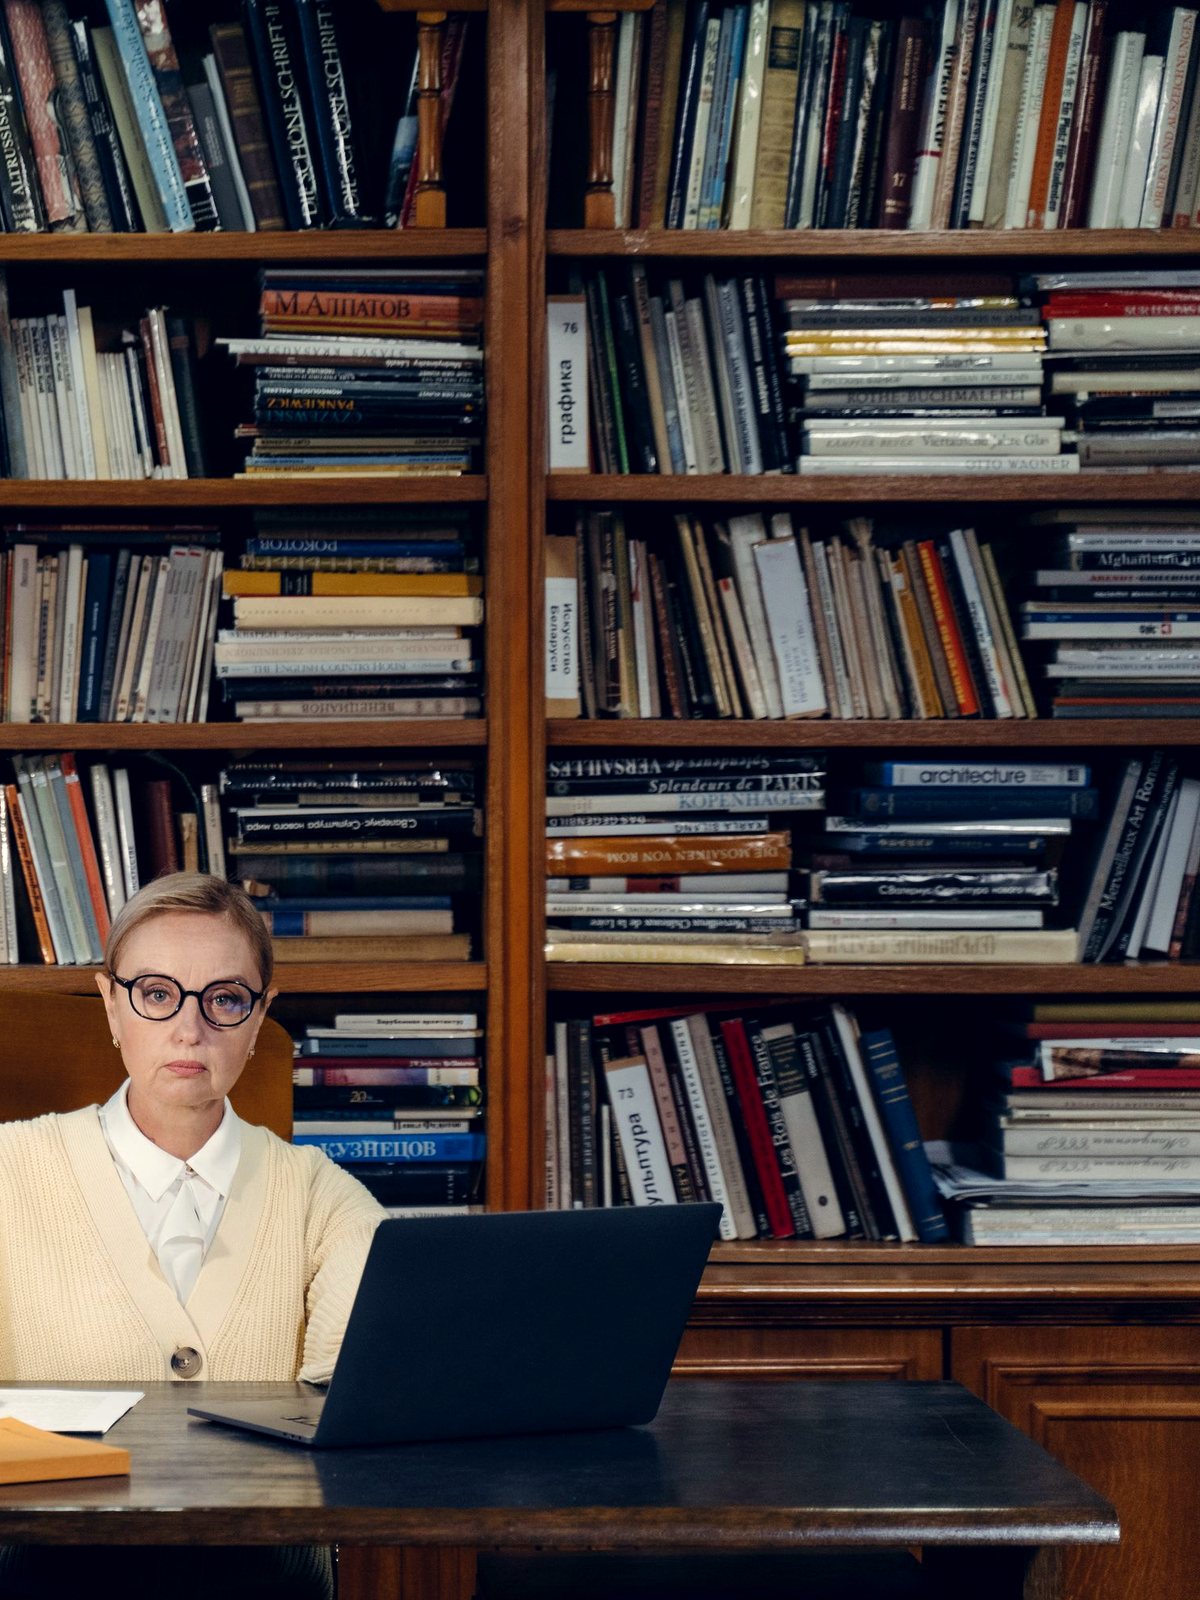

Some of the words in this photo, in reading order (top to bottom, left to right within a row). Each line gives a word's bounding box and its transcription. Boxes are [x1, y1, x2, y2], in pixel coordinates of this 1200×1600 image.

[1163, 14, 1196, 127] AUSZEICHNUNGEN
[1060, 100, 1073, 114] Ein
[1056, 116, 1071, 141] Platz
[1055, 143, 1067, 158] für
[1160, 130, 1175, 160] UND
[892, 172, 905, 187] 17
[1046, 160, 1064, 212] Studenten
[1152, 163, 1170, 208] ORDEN
[275, 291, 411, 318] М.АЛПАТОВ
[562, 322, 578, 334] 76
[243, 344, 340, 357] KRASAUSKAS
[351, 347, 406, 358] STASYS
[266, 396, 354, 411] PANKIEWICZ
[557, 359, 576, 445] графика
[907, 388, 1025, 404] BUCHMALEREI
[966, 461, 1001, 470] OTTO
[1007, 460, 1070, 470] WAGNER
[259, 538, 337, 552] РОКОТОВ
[1098, 552, 1179, 567] Afghanistan
[562, 602, 573, 676] Искусство
[274, 664, 316, 673] ENGLISH
[300, 700, 394, 712] ВЕНЕЦИАНОВ
[552, 756, 662, 778] VERSAILLES
[665, 758, 683, 772] de
[689, 753, 769, 772] Splendeurs
[919, 767, 1026, 784] architecture
[647, 776, 731, 795] Splendeurs
[734, 776, 753, 791] de
[761, 773, 821, 791] PARIS
[679, 792, 814, 809] KOPENHAGEN
[244, 821, 271, 831] мира
[273, 821, 304, 830] нового
[306, 817, 360, 831] Скульптура
[607, 851, 638, 864] ROM
[641, 850, 671, 863] VON
[675, 846, 750, 862] MOSAIKEN
[750, 845, 779, 858] DIE
[1092, 827, 1145, 912] Merveilleux
[1125, 802, 1148, 830] Art
[589, 918, 615, 928] Loire
[616, 919, 627, 928] la
[628, 919, 642, 928] de
[643, 919, 691, 929] Châteaux
[692, 919, 746, 930] Merveilleux
[674, 1019, 702, 1108] PLAKATKUNST
[747, 1032, 775, 1087] France
[350, 1090, 367, 1103] 20
[760, 1087, 780, 1109] de
[765, 1109, 790, 1146] Rois
[323, 1140, 436, 1159] КУЗНЕЦОВ
[696, 1113, 718, 1176] LEIPZIGER
[1035, 1138, 1089, 1150] СССР
[774, 1146, 798, 1178] Les
[1039, 1159, 1090, 1172] СССР
